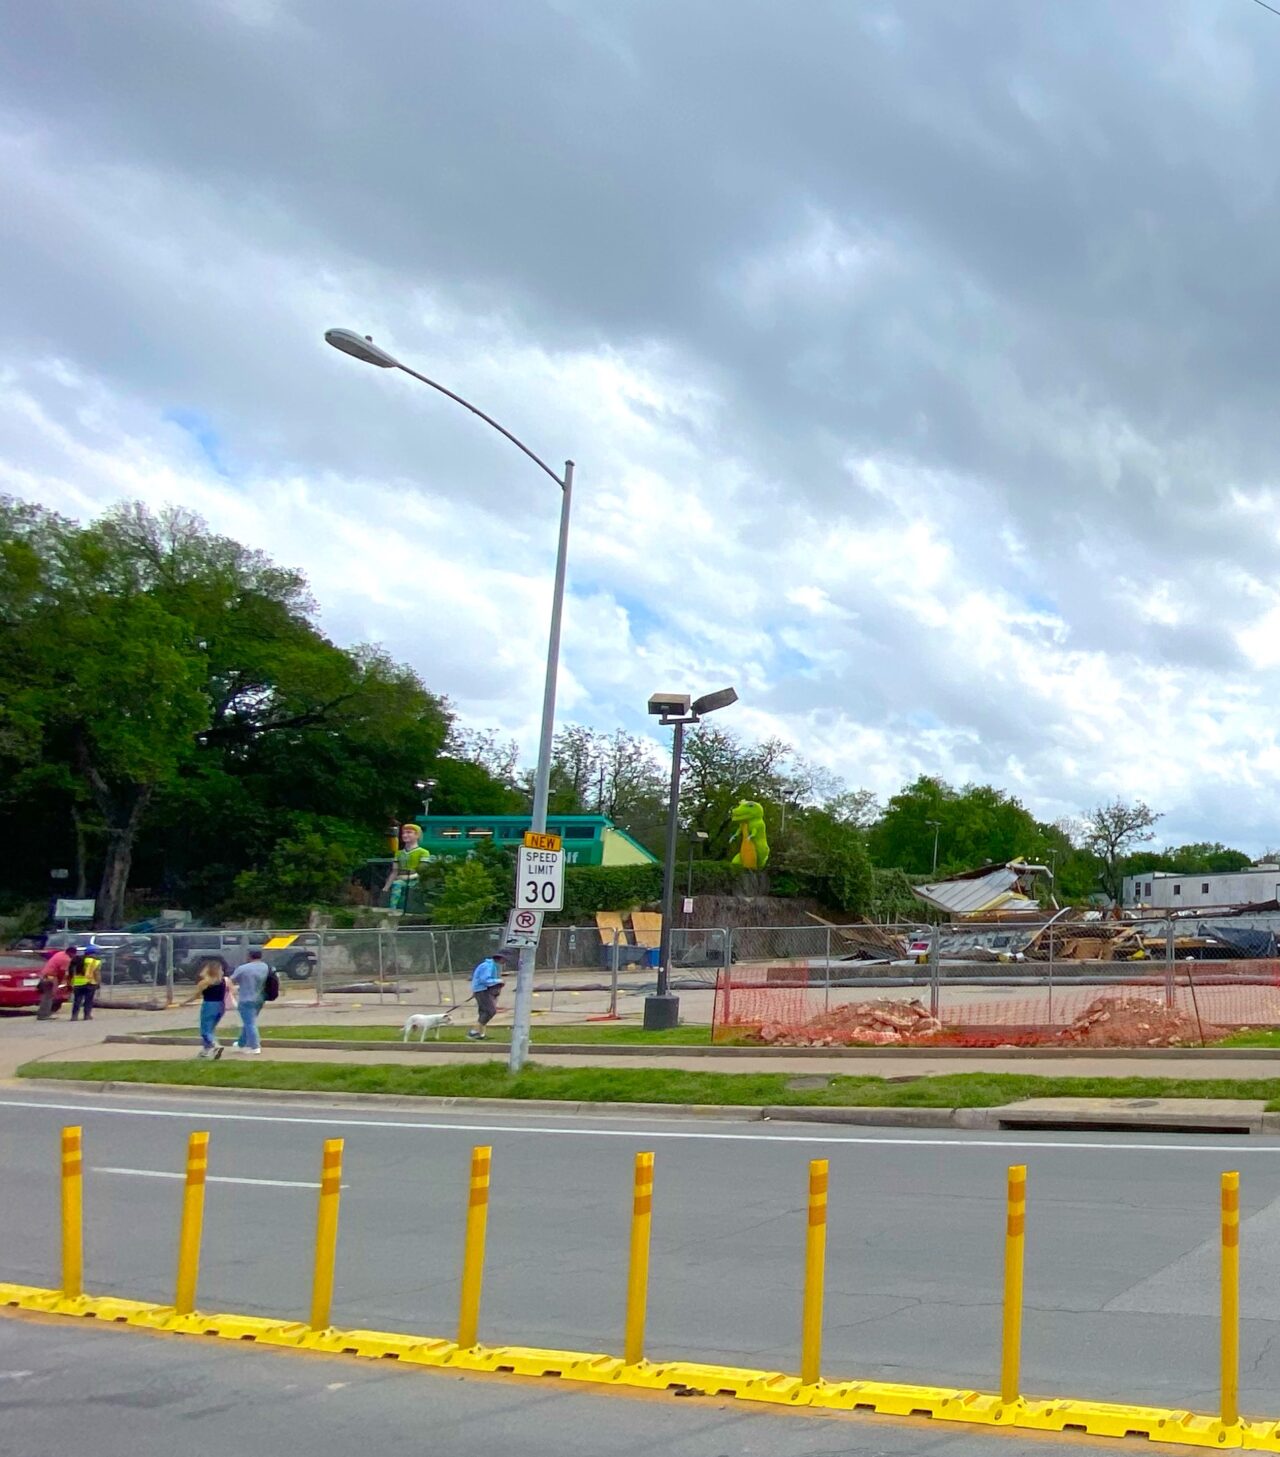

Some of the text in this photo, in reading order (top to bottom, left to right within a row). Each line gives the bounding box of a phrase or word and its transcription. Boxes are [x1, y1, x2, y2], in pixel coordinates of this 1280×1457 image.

[530, 835, 555, 849] NEW
[526, 852, 557, 863] SPEED
[528, 865, 554, 875] LIMIT
[525, 881, 555, 903] 30
